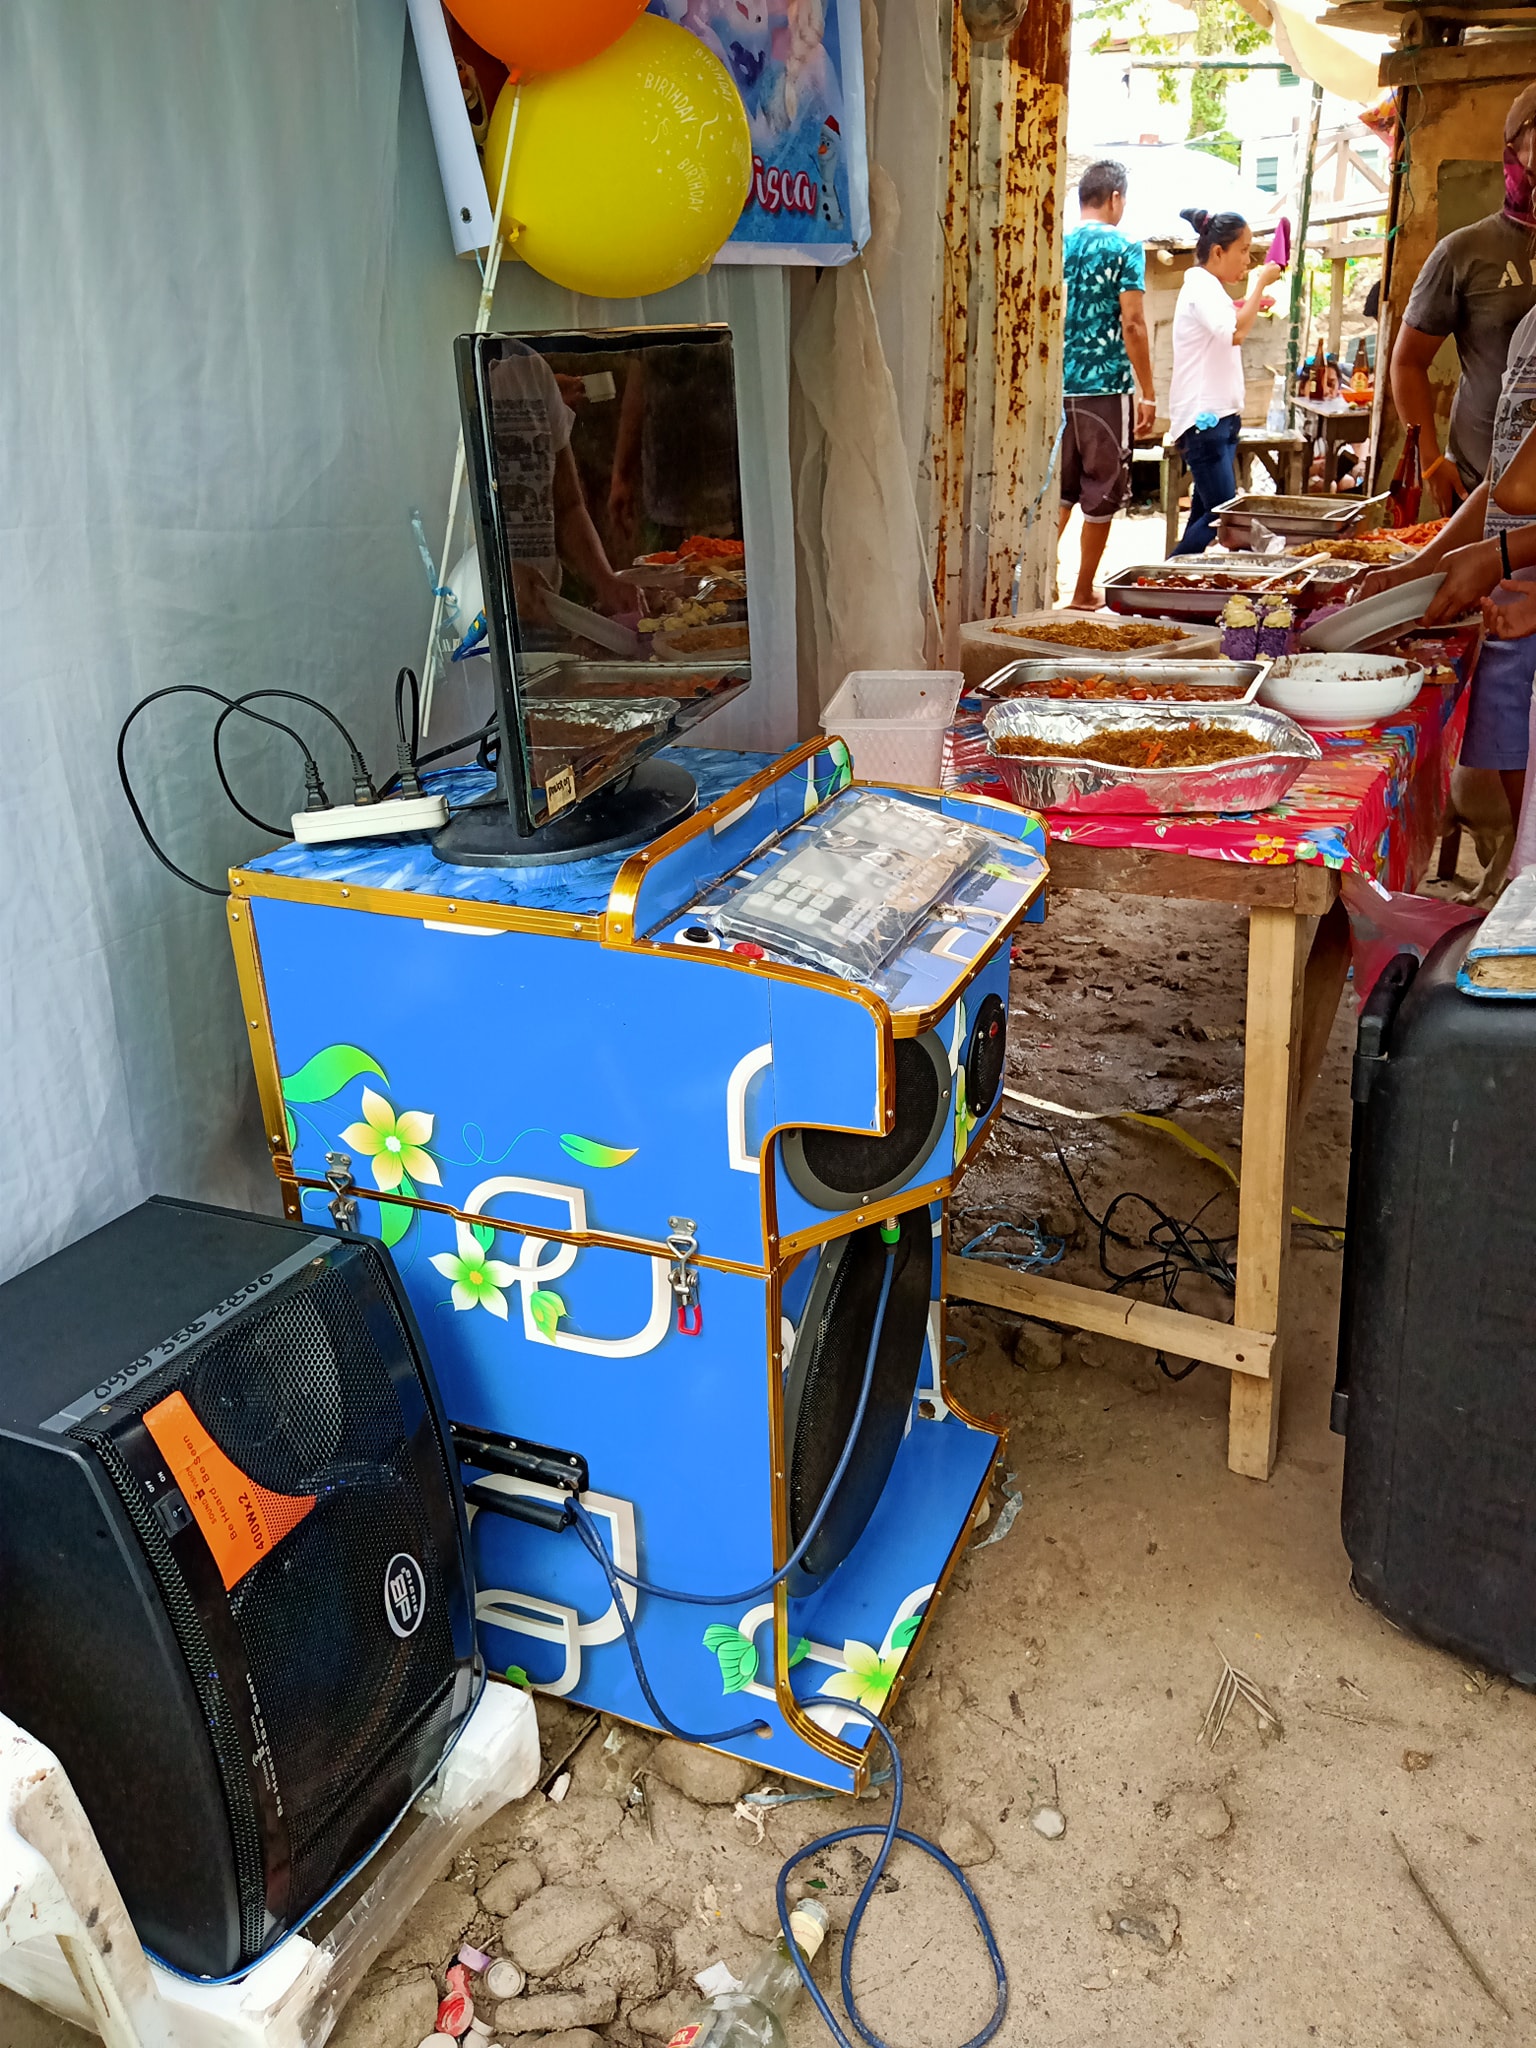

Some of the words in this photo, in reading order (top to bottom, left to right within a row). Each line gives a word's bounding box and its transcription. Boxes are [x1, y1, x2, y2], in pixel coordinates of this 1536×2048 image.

[644, 73, 699, 124] BIRTHDAY
[695, 48, 734, 106] BIRTHDAY
[676, 157, 705, 213] BIRTHDAY
[751, 156, 817, 214] isca
[94, 1355, 152, 1399] 0909
[153, 1321, 206, 1355] 358
[211, 1273, 273, 1316] 2800
[183, 1435, 201, 1465] Seen
[200, 1466, 210, 1483] Be
[201, 1498, 217, 1525] SOUND
[228, 1523, 238, 1541] Be
[238, 1492, 264, 1550] 400Wx2
